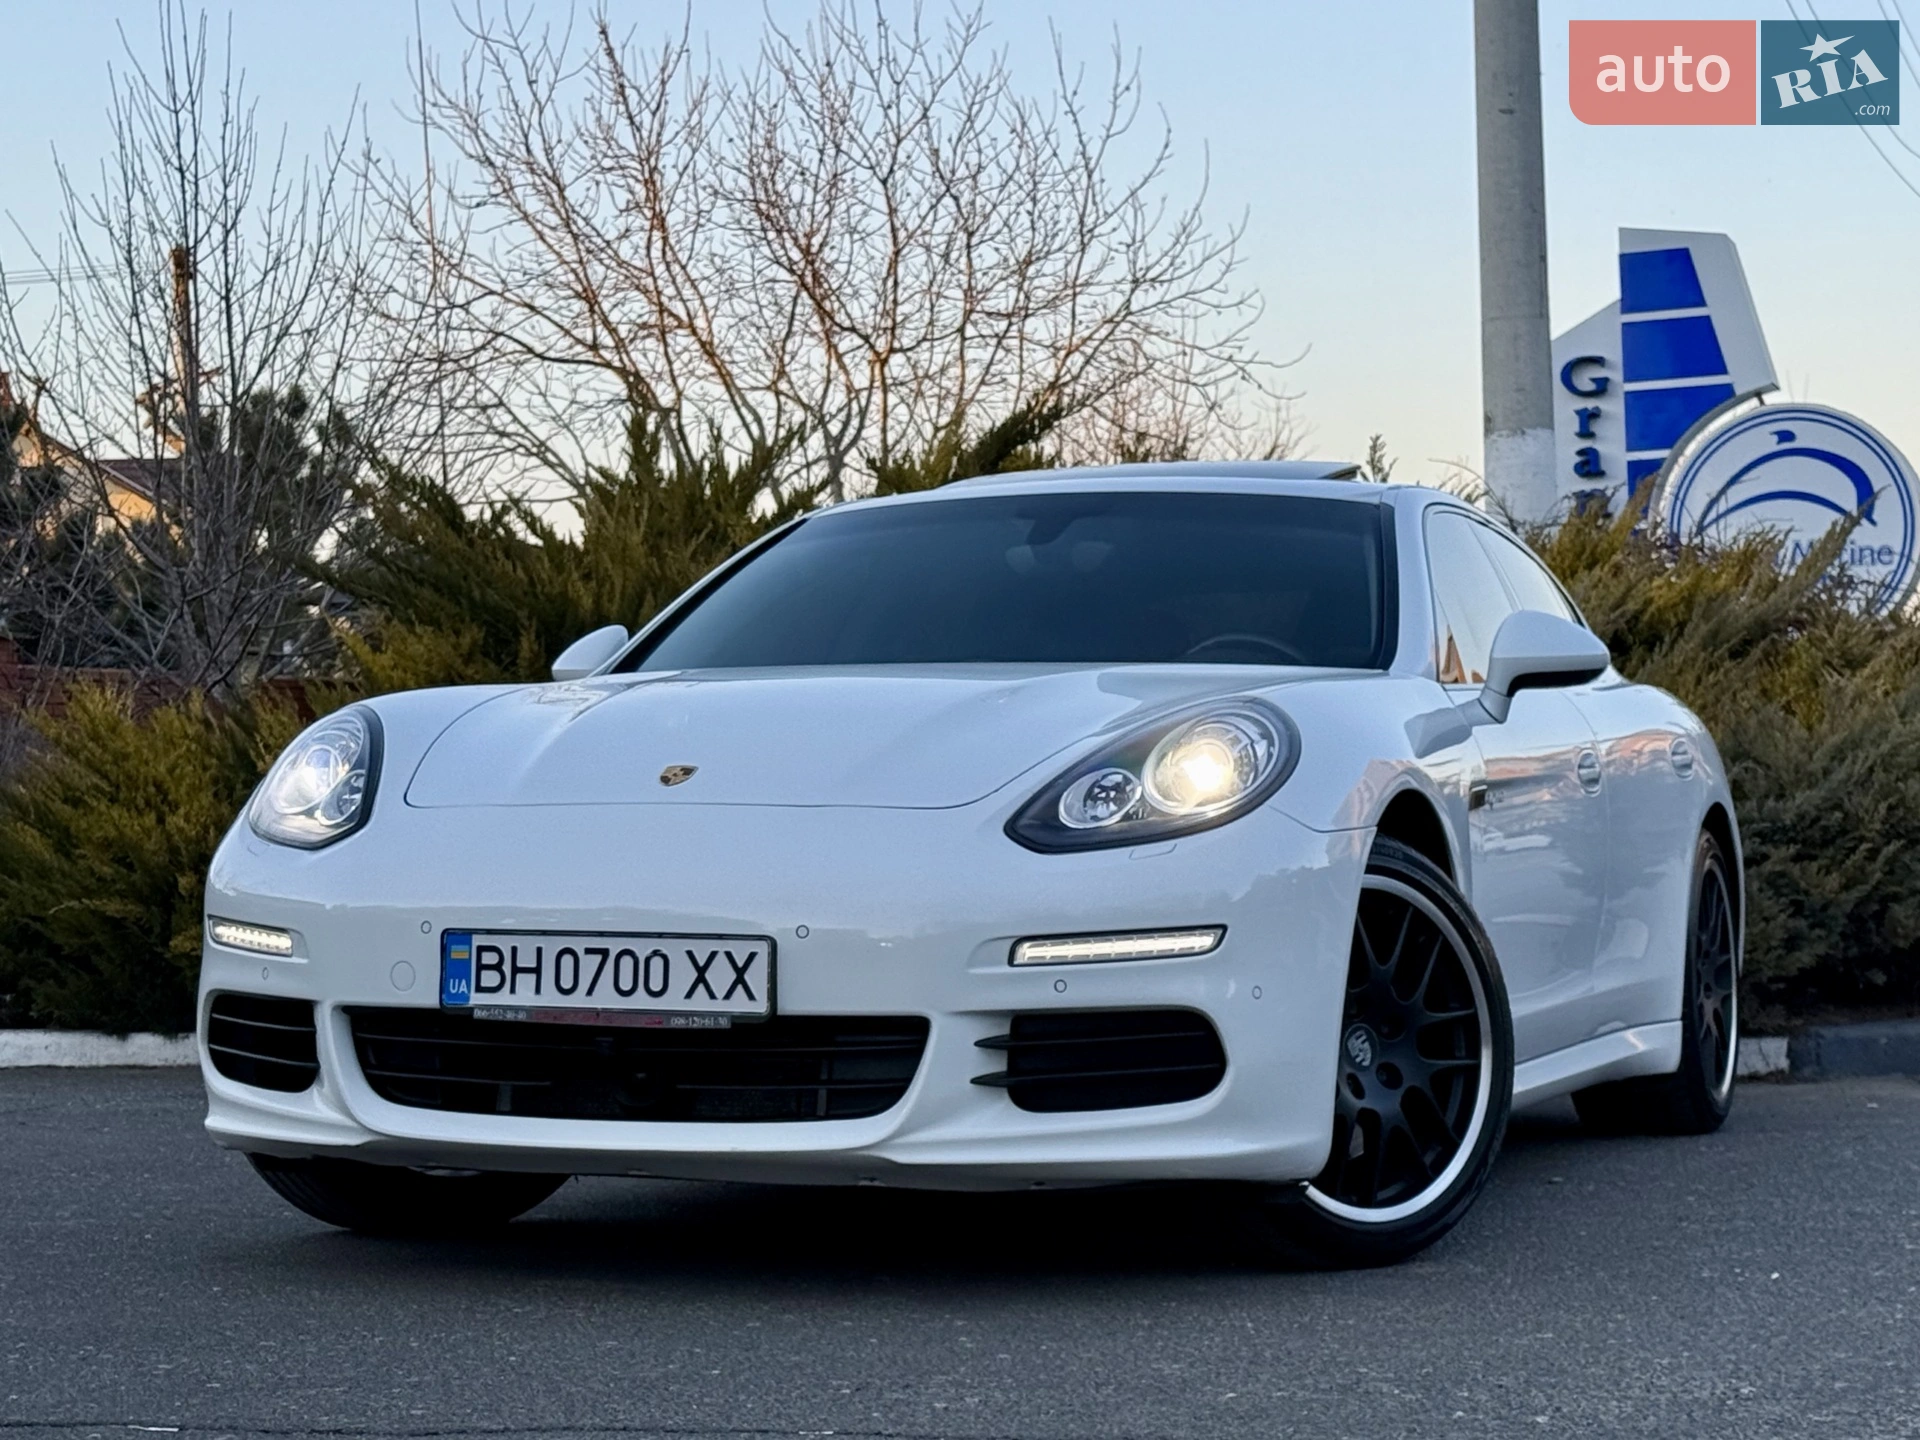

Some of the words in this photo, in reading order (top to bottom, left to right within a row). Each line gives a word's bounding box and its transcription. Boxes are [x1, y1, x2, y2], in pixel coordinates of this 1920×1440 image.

[1789, 540, 1894, 566] Mrine
[474, 945, 543, 996] BH
[554, 947, 670, 998] 0700
[683, 950, 759, 1002] XX
[450, 979, 469, 995] UA
